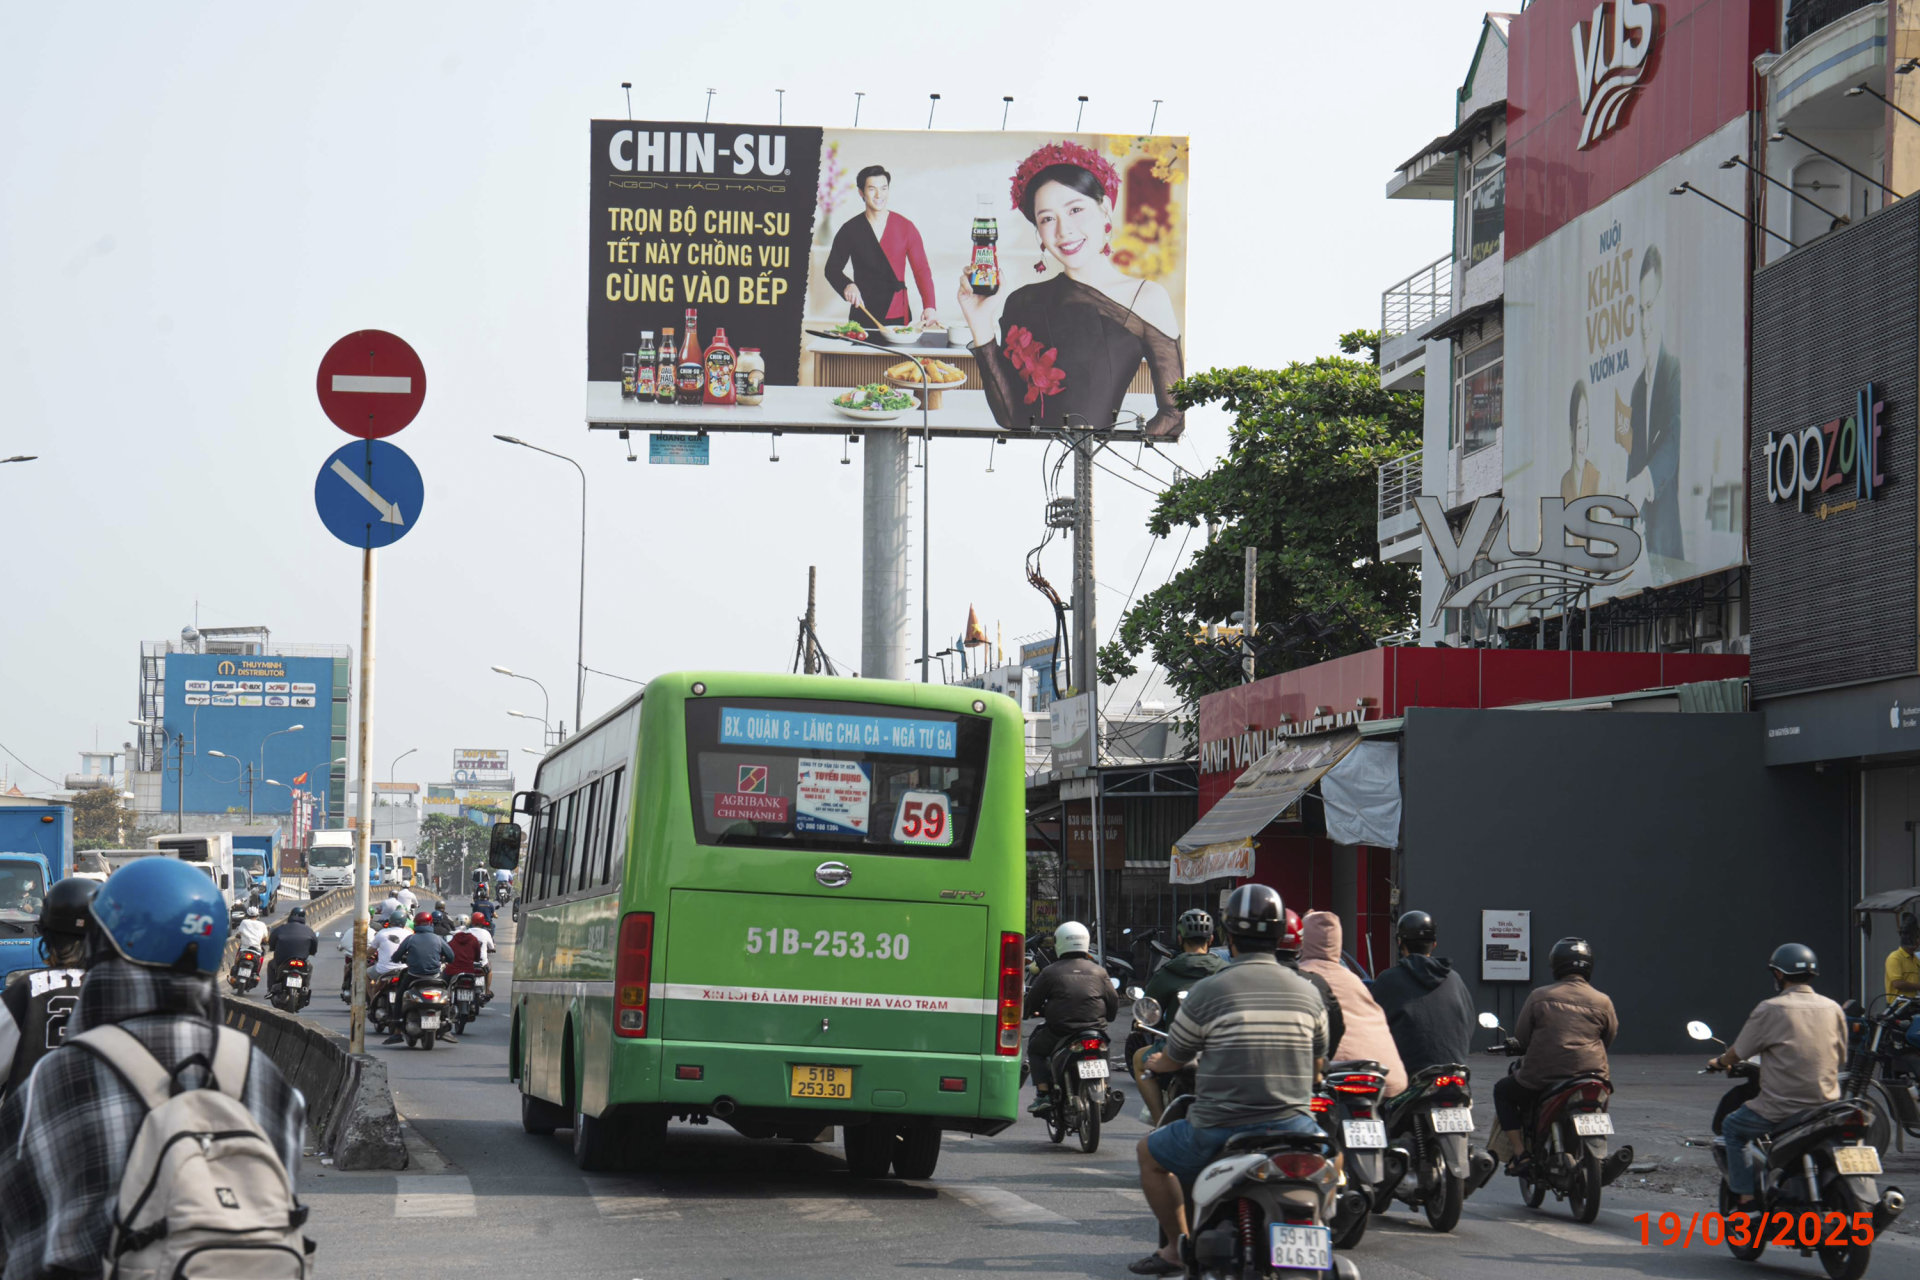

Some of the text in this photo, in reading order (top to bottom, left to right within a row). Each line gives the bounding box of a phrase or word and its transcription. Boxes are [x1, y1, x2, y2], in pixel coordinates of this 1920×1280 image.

[608, 206, 790, 237] TRỌN BỘ CHIN-SU
[1600, 219, 1621, 254] NUÔI
[607, 237, 790, 268] TẾT NÀY CHỒNG VUI
[605, 269, 788, 305] CÙNG VÀO BẾP
[1588, 243, 1633, 311] KHÁT
[1586, 294, 1635, 354] VỌNG
[1590, 349, 1629, 384] VƯƠN XA
[1410, 495, 1641, 580] VUS
[238, 668, 285, 677] DISTRIBUTOR
[724, 716, 743, 737] BX.
[747, 714, 779, 743] QUẬN
[783, 720, 790, 740] 8
[803, 718, 833, 743] LĂNG
[837, 723, 860, 744] CHA
[864, 720, 880, 746] CẢ
[892, 723, 915, 748] NGÃ
[919, 728, 934, 749] TƯ
[937, 729, 952, 750] GA
[457, 757, 489, 769] TUYẾT
[463, 750, 500, 758] HOTEL
[1200, 740, 1230, 774] ANH
[840, 773, 862, 784] DỤNG
[721, 795, 780, 808] AGRIBANK
[717, 809, 736, 817] CHI
[738, 809, 776, 820] NHÁNH
[902, 801, 945, 840] 59
[1068, 815, 1079, 825] 638
[1074, 830, 1084, 840] P.6
[940, 890, 985, 900] CITY
[181, 913, 214, 936] 5G
[746, 927, 910, 960] 51B-253.30
[841, 997, 862, 1006] KHI
[866, 997, 881, 1007] RA
[916, 1000, 948, 1011] TRẠM
[809, 1068, 835, 1081] 51B
[1082, 1061, 1103, 1069] 49-G1
[798, 1082, 845, 1096] 253.30
[1280, 1227, 1319, 1247] 59-N1
